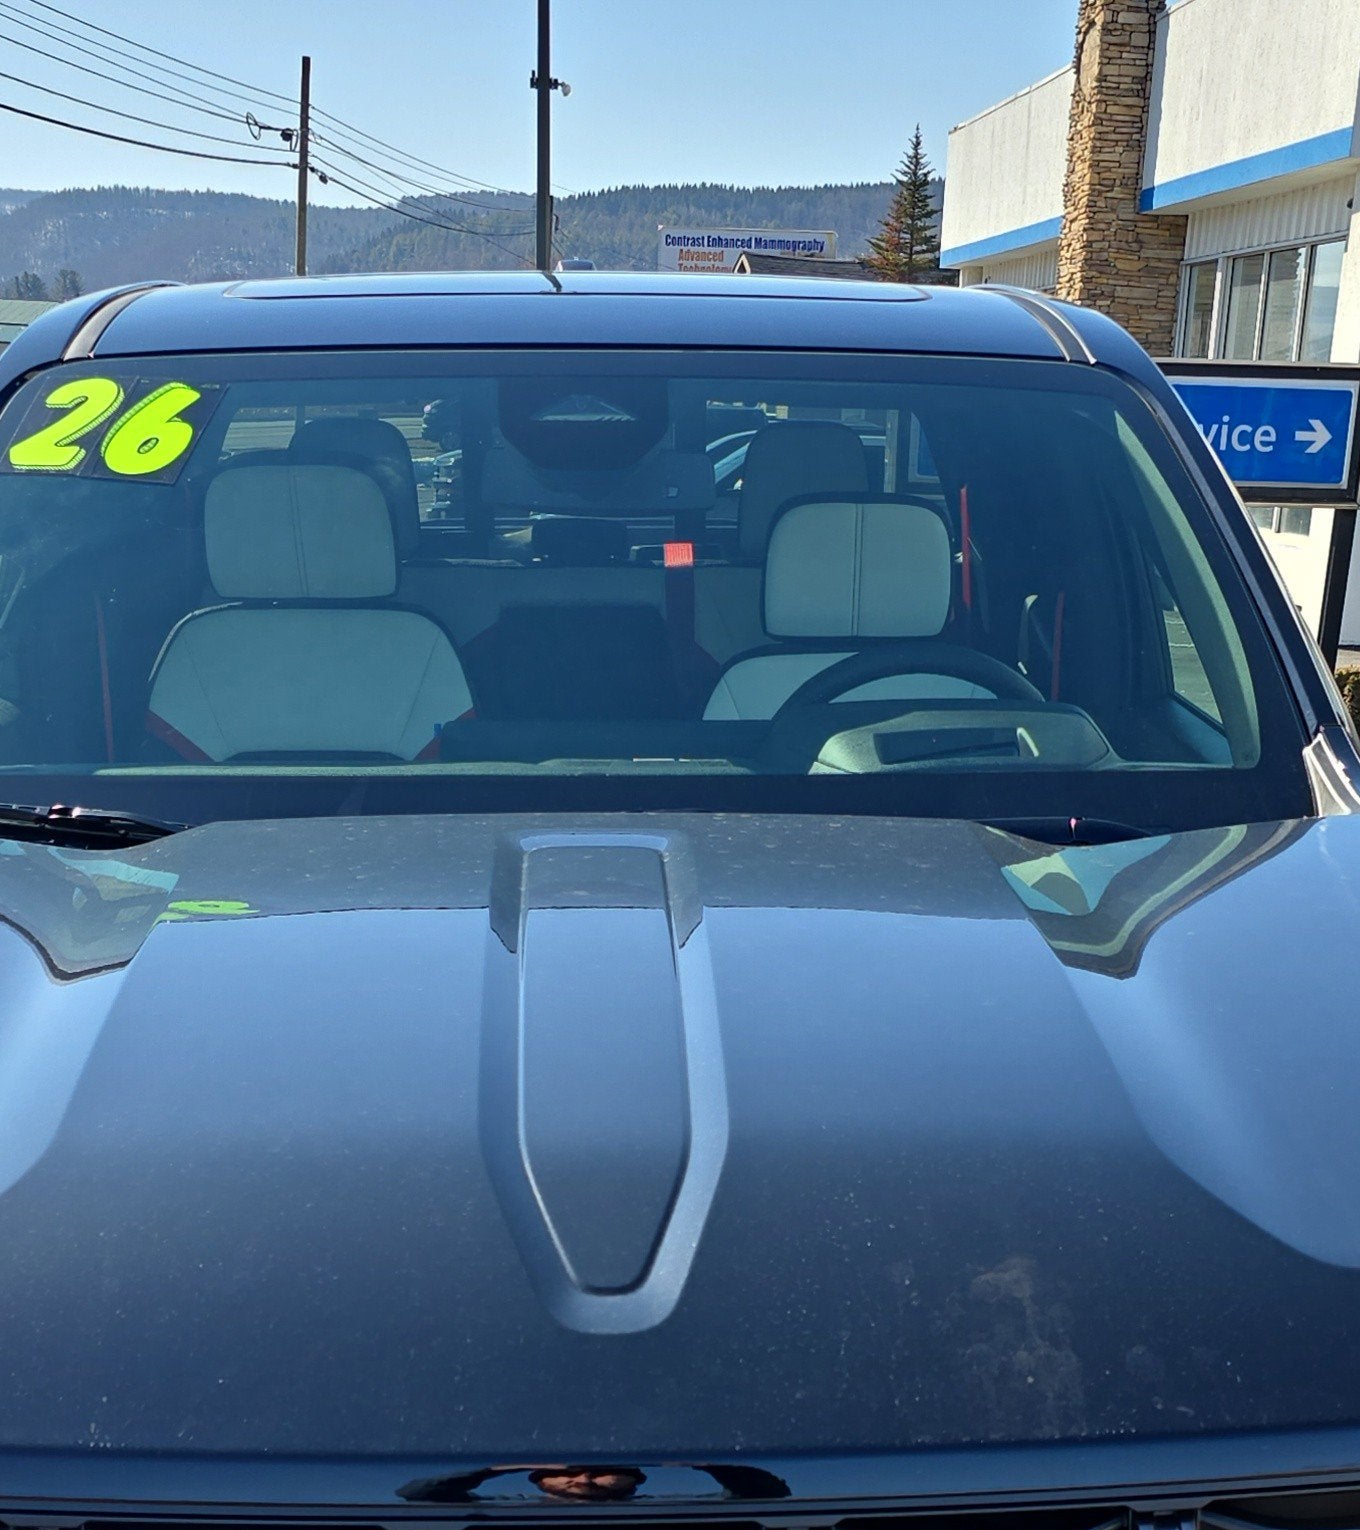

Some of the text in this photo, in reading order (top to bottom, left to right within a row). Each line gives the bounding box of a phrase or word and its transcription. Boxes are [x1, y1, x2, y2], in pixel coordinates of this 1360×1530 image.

[665, 234, 825, 253] Contrast Enhanced Mammography
[678, 249, 724, 262] Advanced
[9, 378, 201, 475] 26
[1197, 415, 1277, 452] vice
